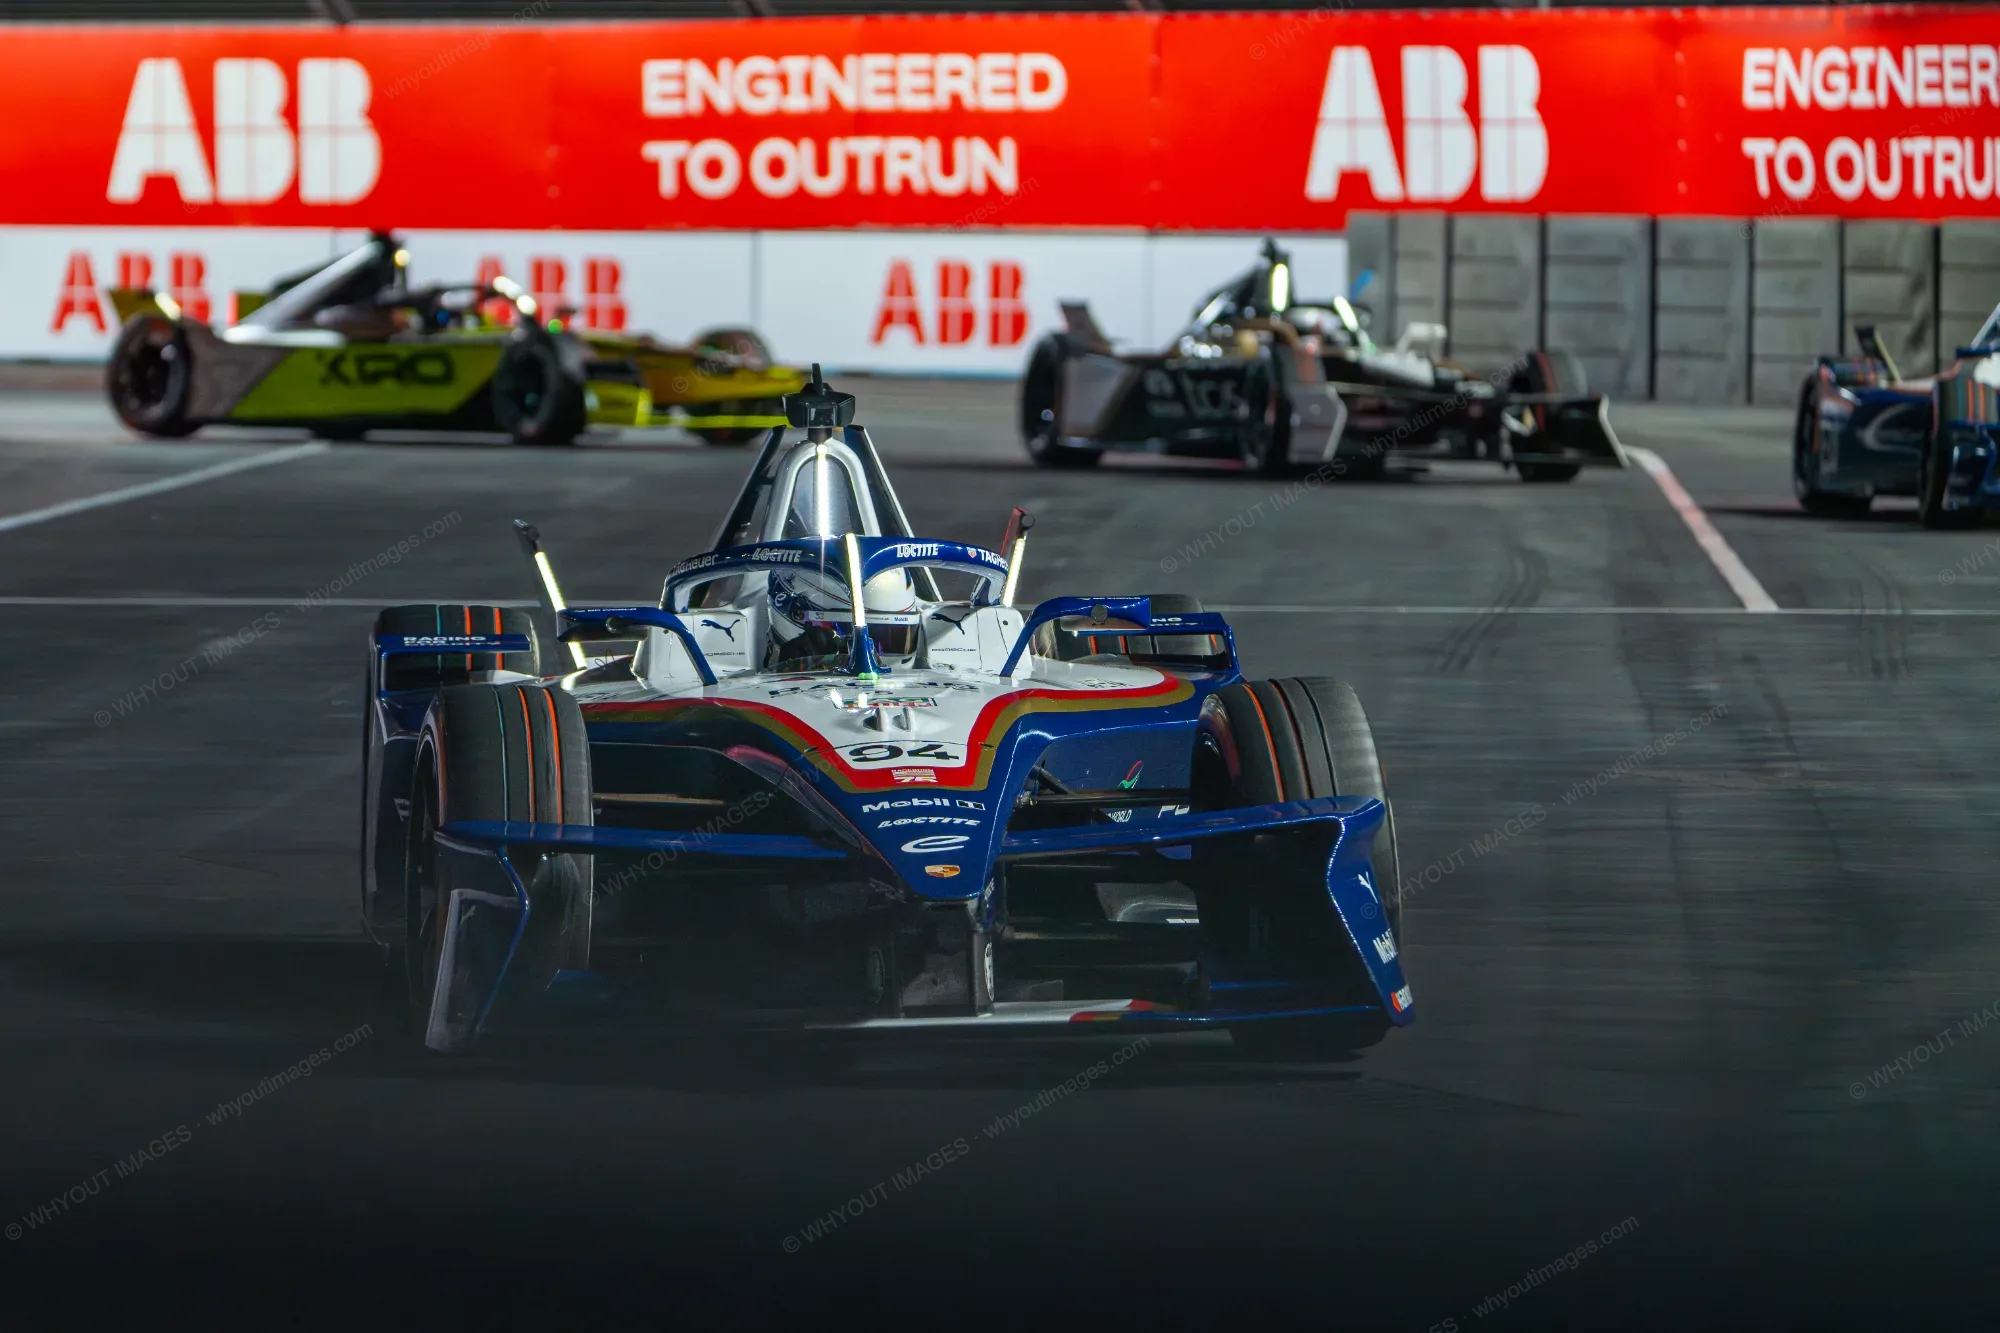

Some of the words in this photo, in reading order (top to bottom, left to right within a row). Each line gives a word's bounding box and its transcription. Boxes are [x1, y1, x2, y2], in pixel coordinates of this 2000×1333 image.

[642, 52, 1068, 117] ENGINEERED
[106, 57, 382, 204] ABB
[1304, 44, 1549, 202] ABB
[642, 139, 742, 199] TO
[749, 136, 1019, 197] OUTRUN
[1742, 137, 1815, 198] TO
[1824, 137, 2000, 199] OUTRU
[871, 258, 1030, 346] ABB
[752, 547, 803, 563] LOCTITE
[897, 543, 939, 558] LOCTITE
[849, 744, 960, 763] 94
[862, 798, 950, 813] Mobil
[877, 817, 981, 829] LOCTITE
